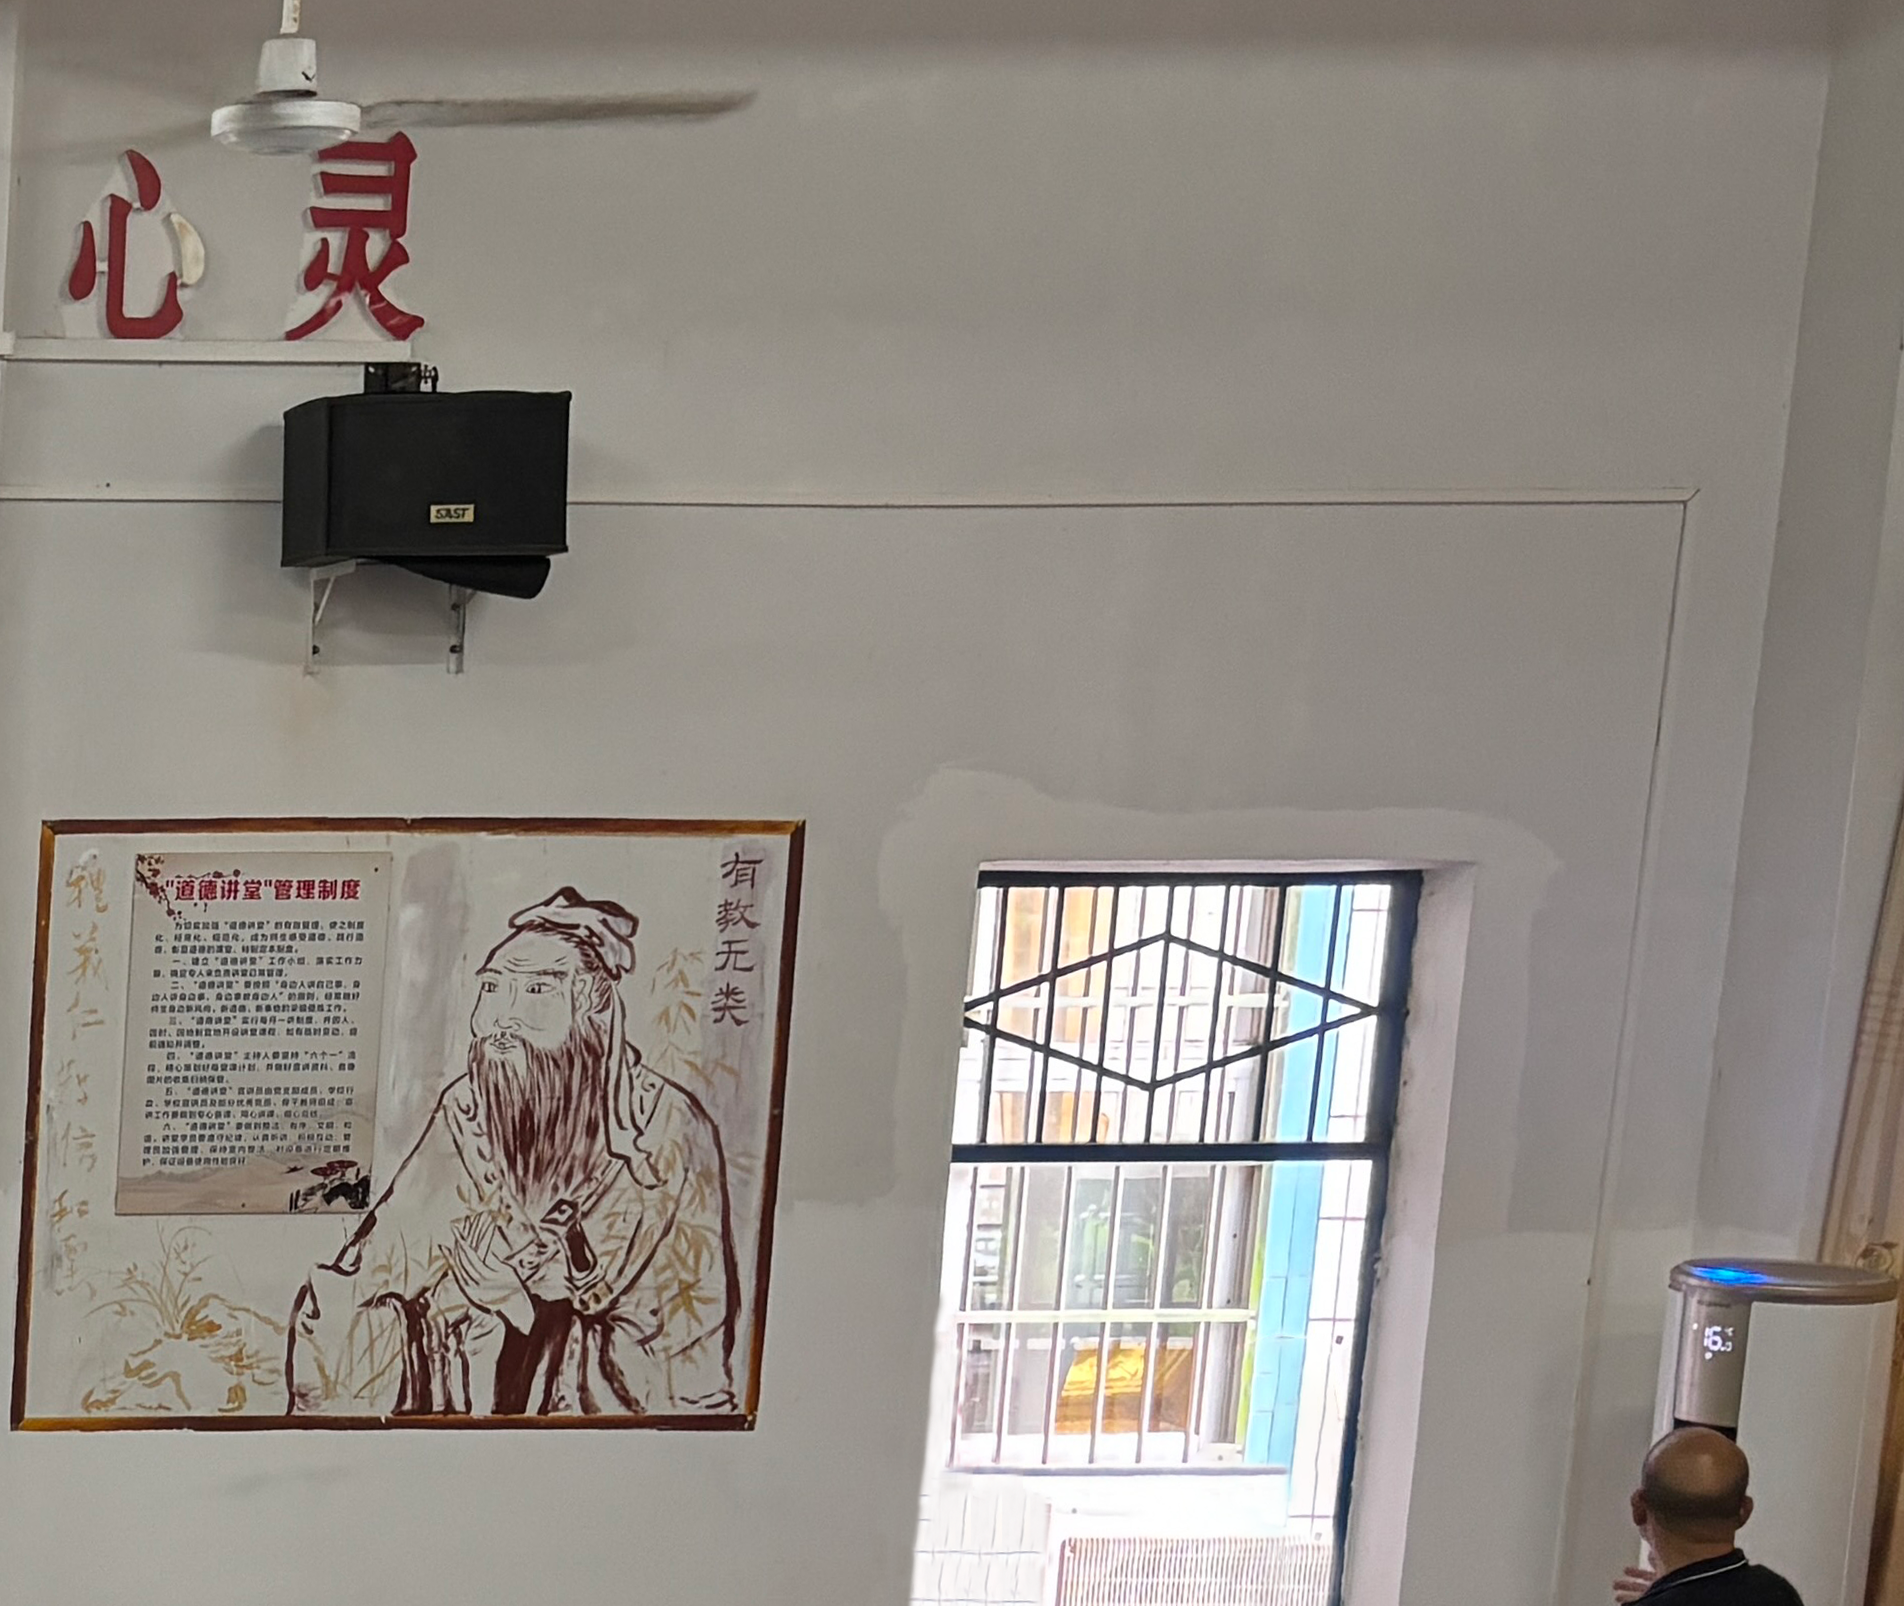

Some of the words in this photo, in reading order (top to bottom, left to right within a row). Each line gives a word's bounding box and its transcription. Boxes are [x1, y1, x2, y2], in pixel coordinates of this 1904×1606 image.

[434, 507, 470, 520] SAST
[710, 851, 765, 1027] 有教无类
